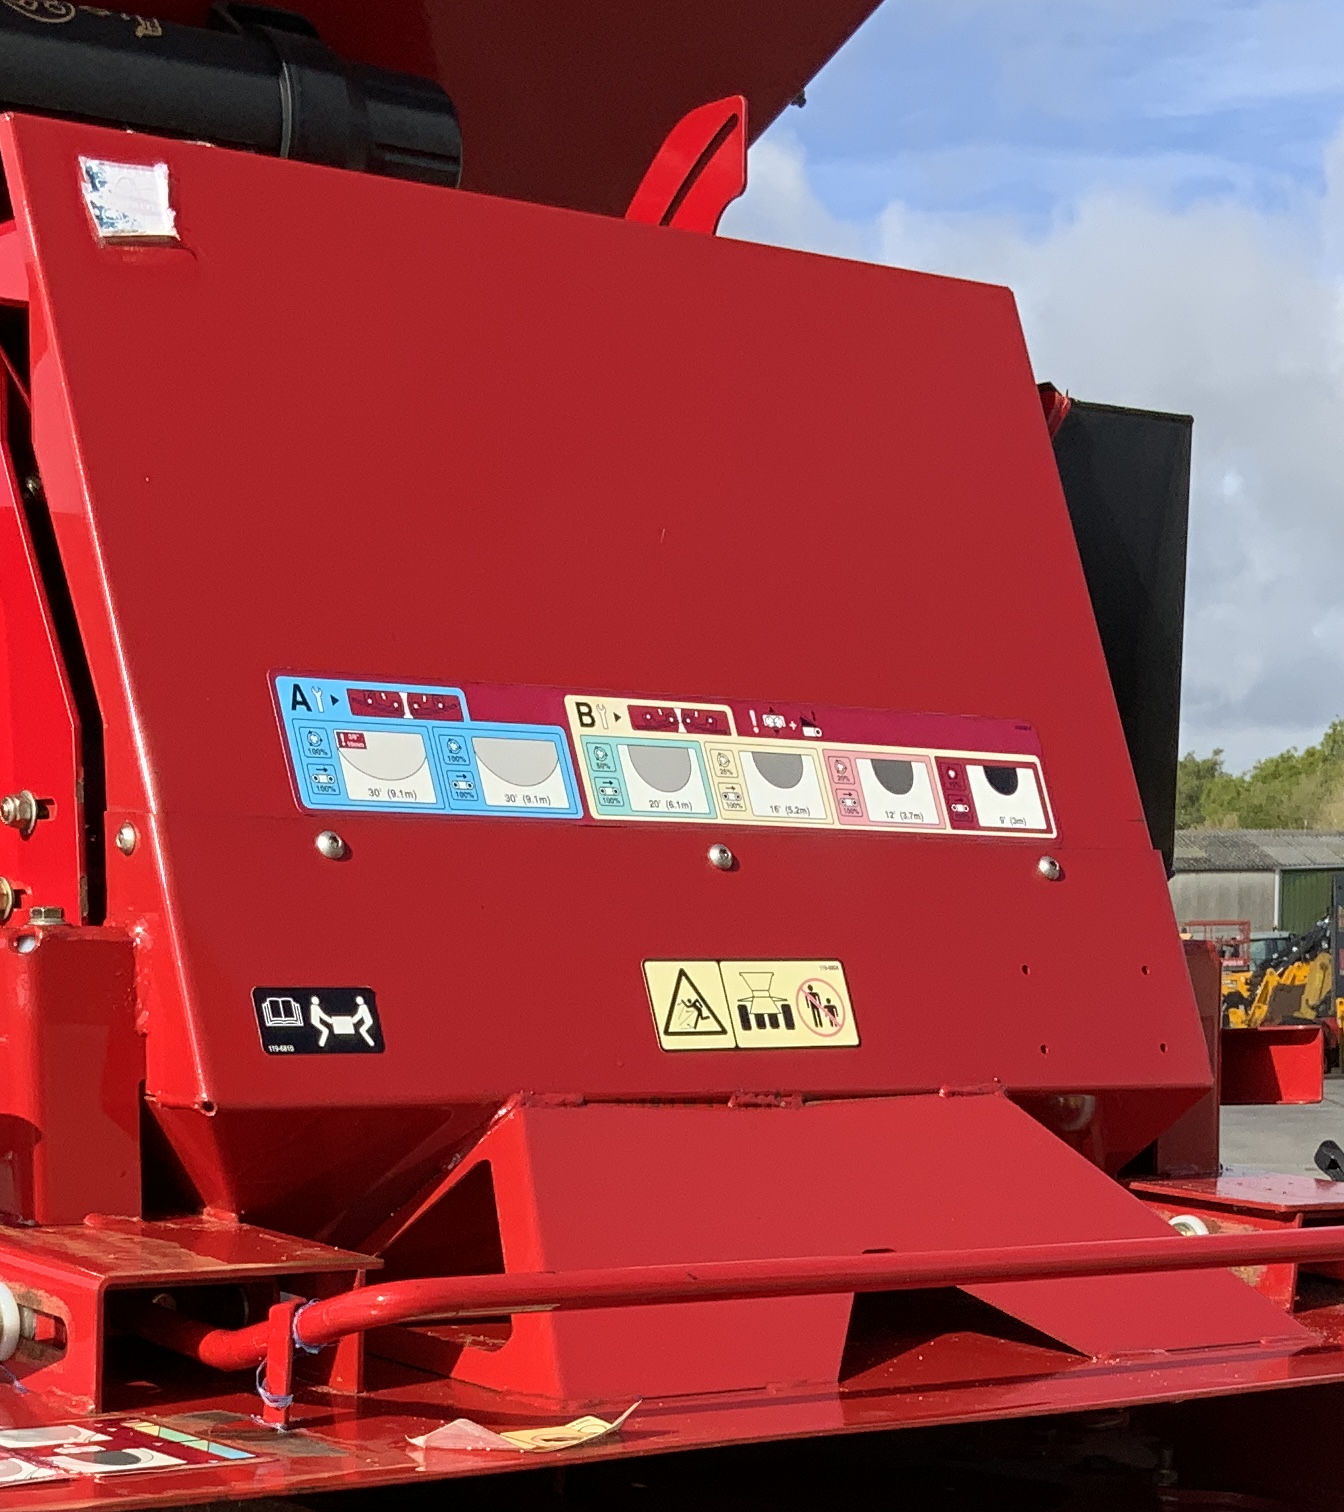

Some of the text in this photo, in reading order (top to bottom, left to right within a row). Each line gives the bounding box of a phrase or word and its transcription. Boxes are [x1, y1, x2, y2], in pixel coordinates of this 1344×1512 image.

[291, 683, 313, 712] A
[575, 702, 596, 728] B
[368, 788, 417, 800] 30' (9.1m)
[504, 794, 551, 806] 30' (9.1m)
[666, 800, 692, 811] (6.1m)
